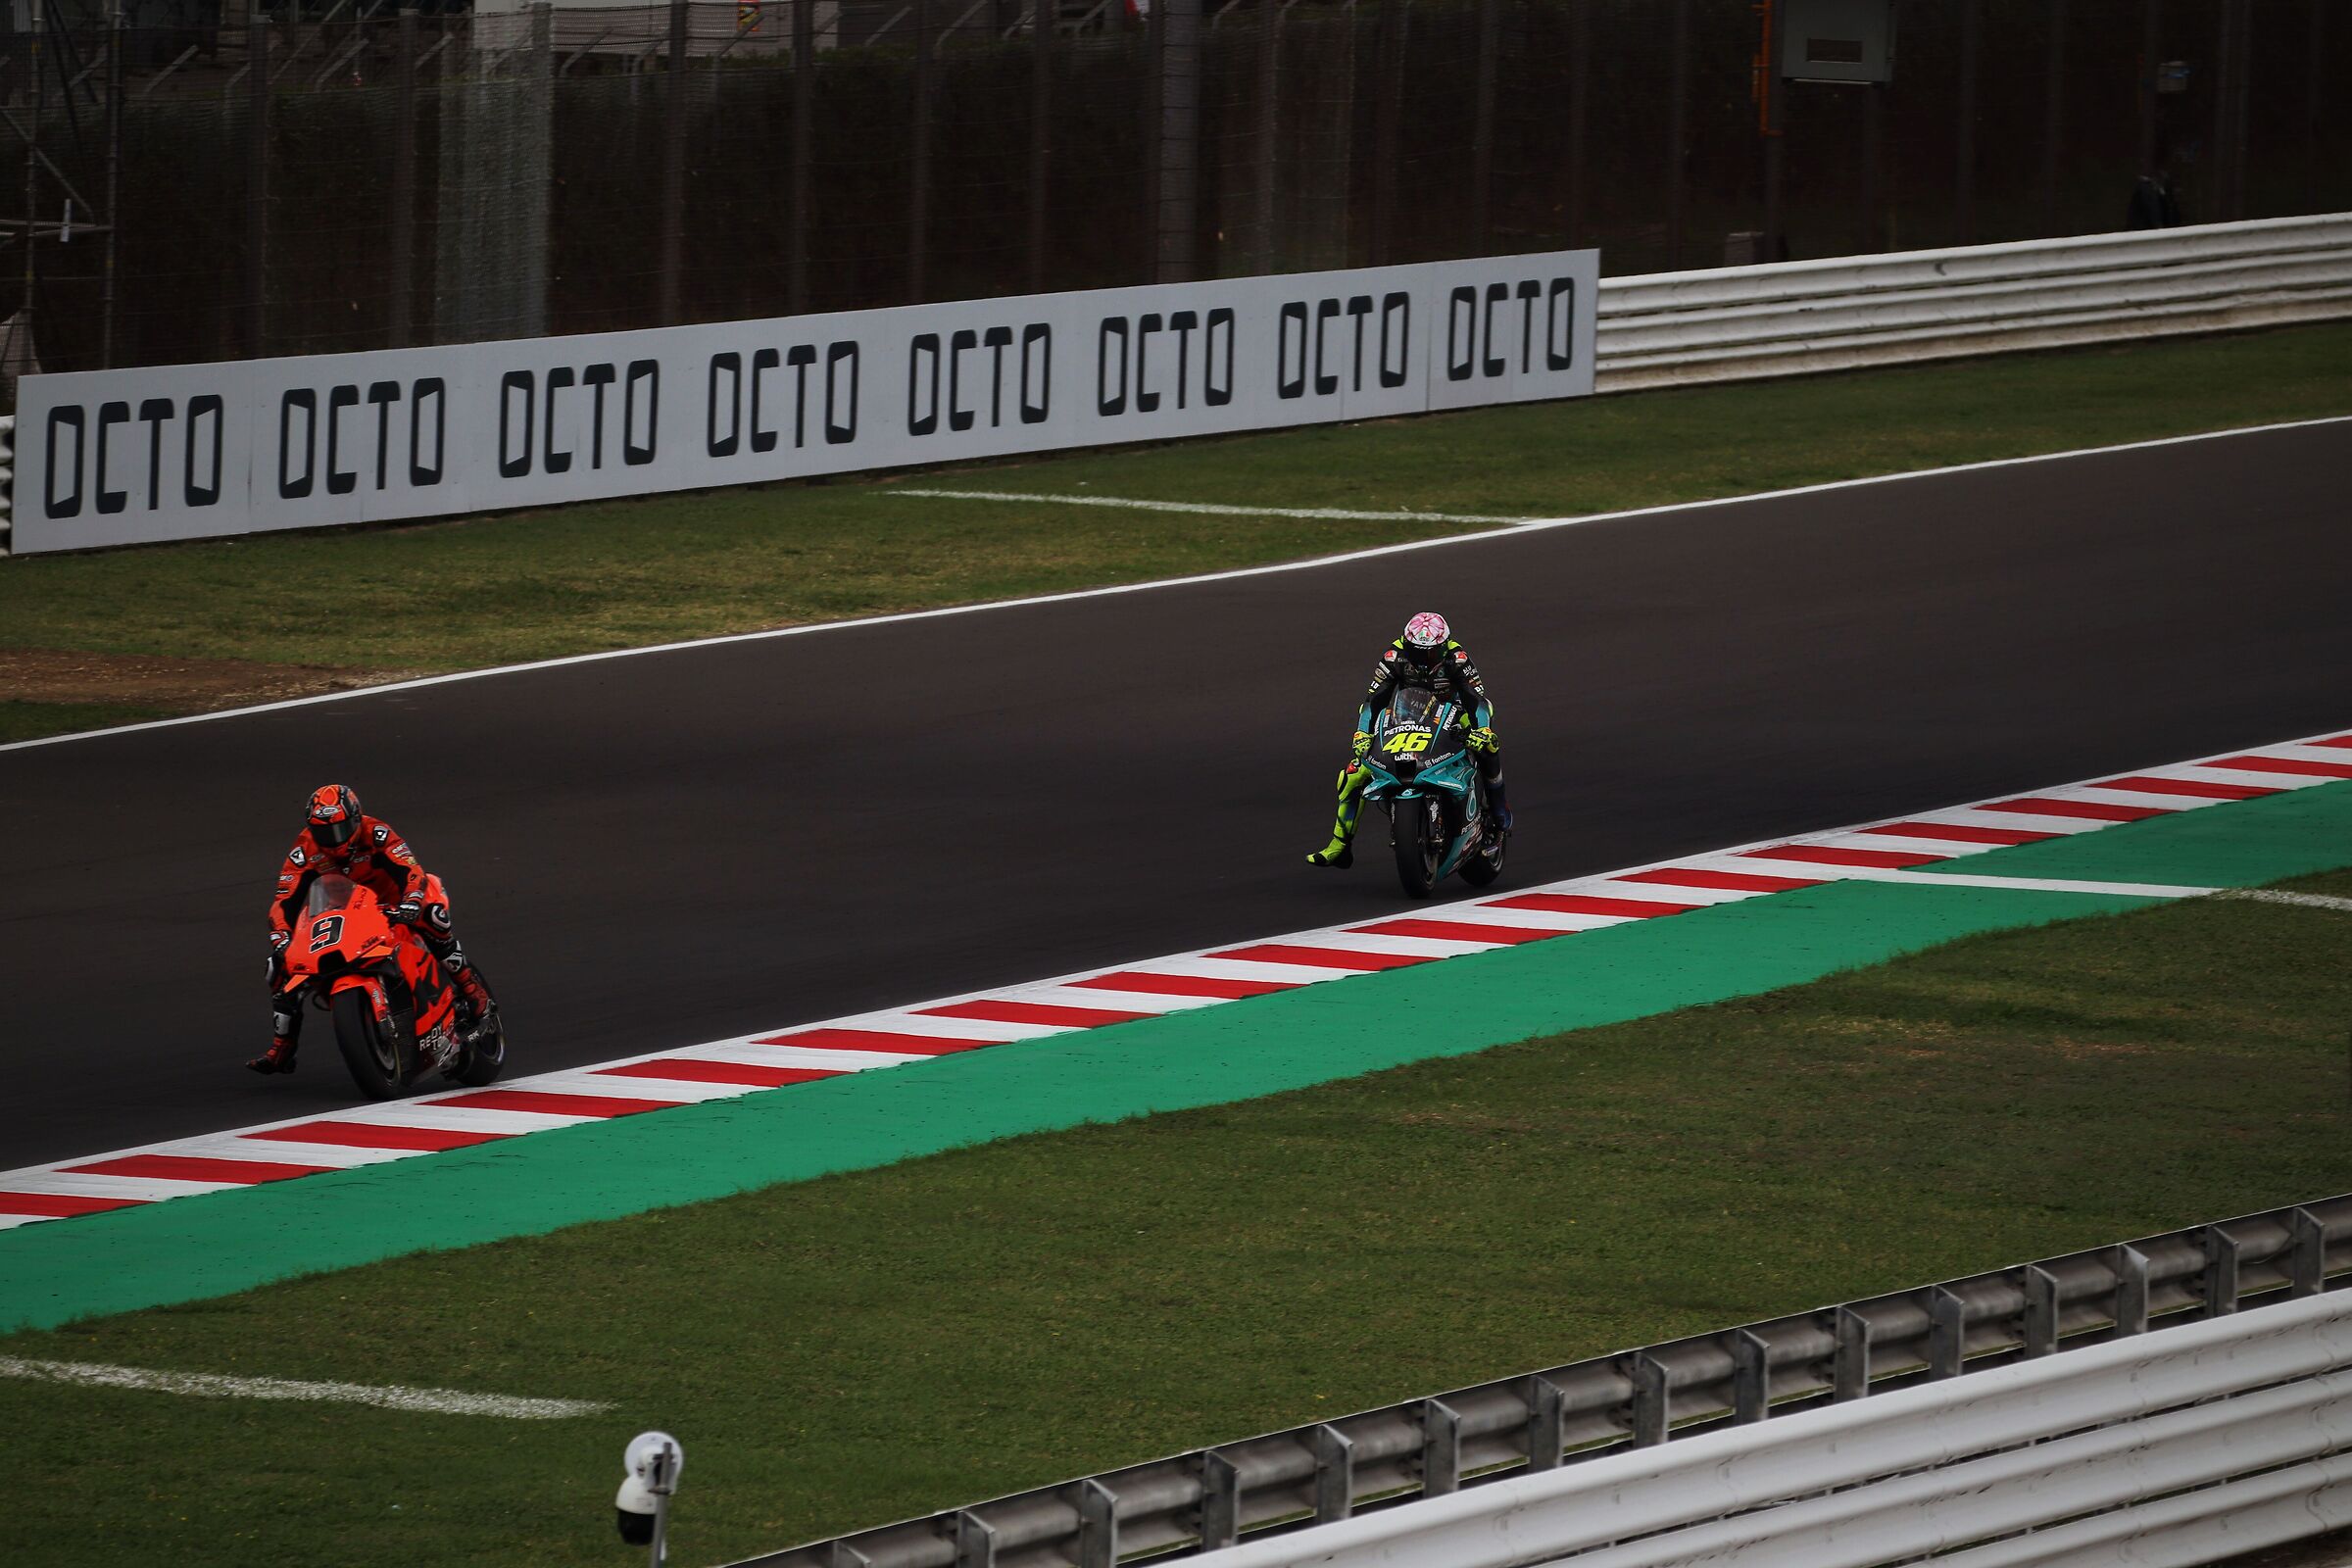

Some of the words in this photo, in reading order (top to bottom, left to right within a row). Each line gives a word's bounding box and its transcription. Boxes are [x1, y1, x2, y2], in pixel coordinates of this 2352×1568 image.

[44, 394, 223, 519] OCTO
[278, 377, 445, 499] OCTO
[499, 360, 659, 478] OCTO
[708, 341, 858, 458] OCTO
[908, 323, 1051, 436] OCTO
[1098, 308, 1234, 416] OCTO
[1278, 292, 1409, 399] OCTO
[1447, 277, 1574, 381] OCTO
[1382, 732, 1434, 754] 46
[1384, 724, 1432, 737] PETRONAS
[310, 914, 345, 954] 9
